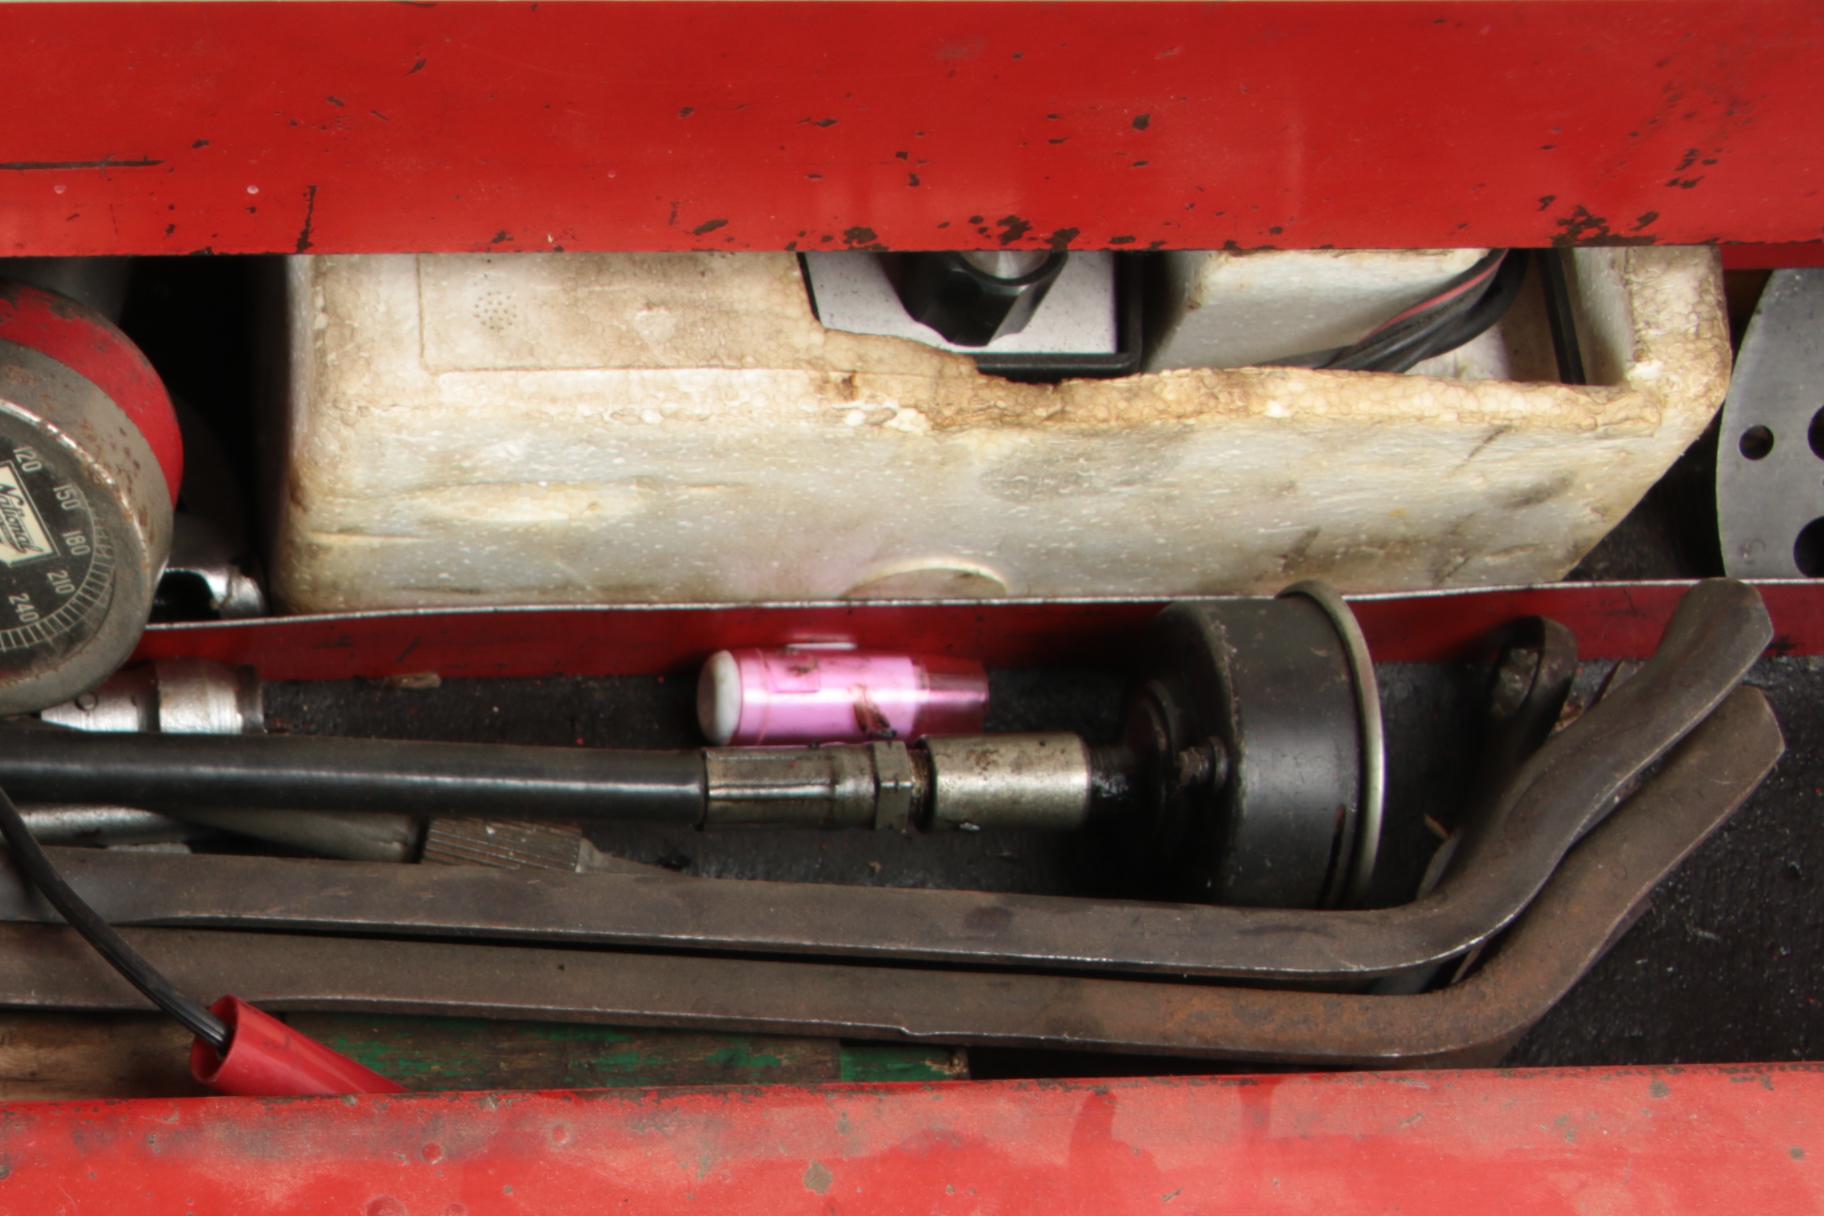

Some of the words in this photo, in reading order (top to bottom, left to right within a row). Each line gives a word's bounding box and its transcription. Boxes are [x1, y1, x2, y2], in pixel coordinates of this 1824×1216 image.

[13, 446, 42, 473] 120
[53, 484, 80, 511] 150
[62, 530, 90, 556] 180
[47, 569, 75, 595] 210
[8, 593, 39, 623] 240
